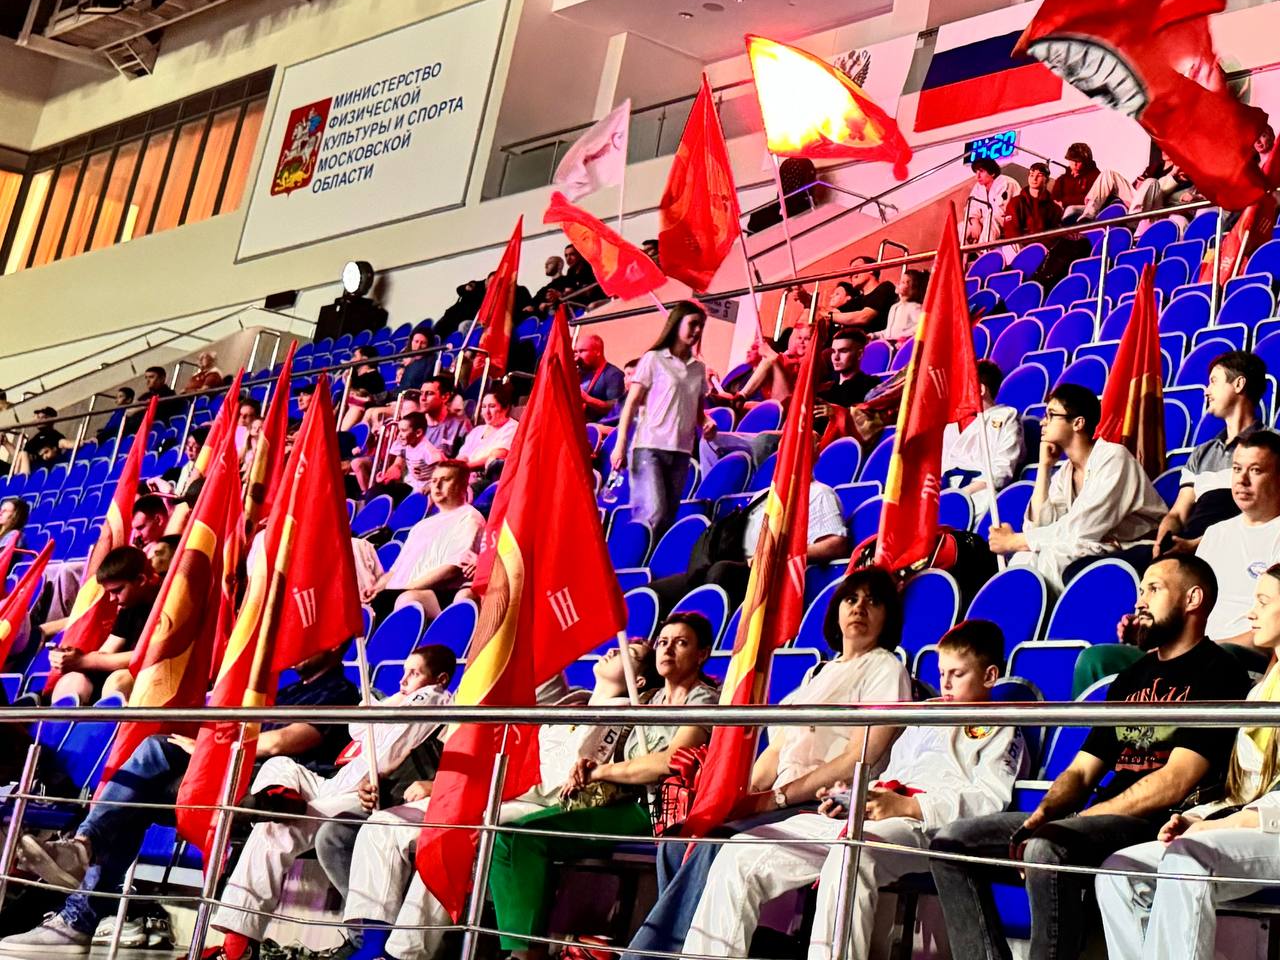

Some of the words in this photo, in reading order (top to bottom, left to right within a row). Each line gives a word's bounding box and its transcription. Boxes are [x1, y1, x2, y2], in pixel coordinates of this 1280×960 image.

[328, 86, 422, 130] ФИЗИЧЕСКОЙ
[333, 62, 442, 110] МИНИСТЕРСТВО
[322, 117, 392, 152] КУЛЬТУРЫ
[394, 113, 405, 131] И
[407, 96, 464, 127] СПОРТА
[316, 129, 413, 173] МОСКОВСКОЙ
[312, 163, 375, 194] ОБЛАСТИ
